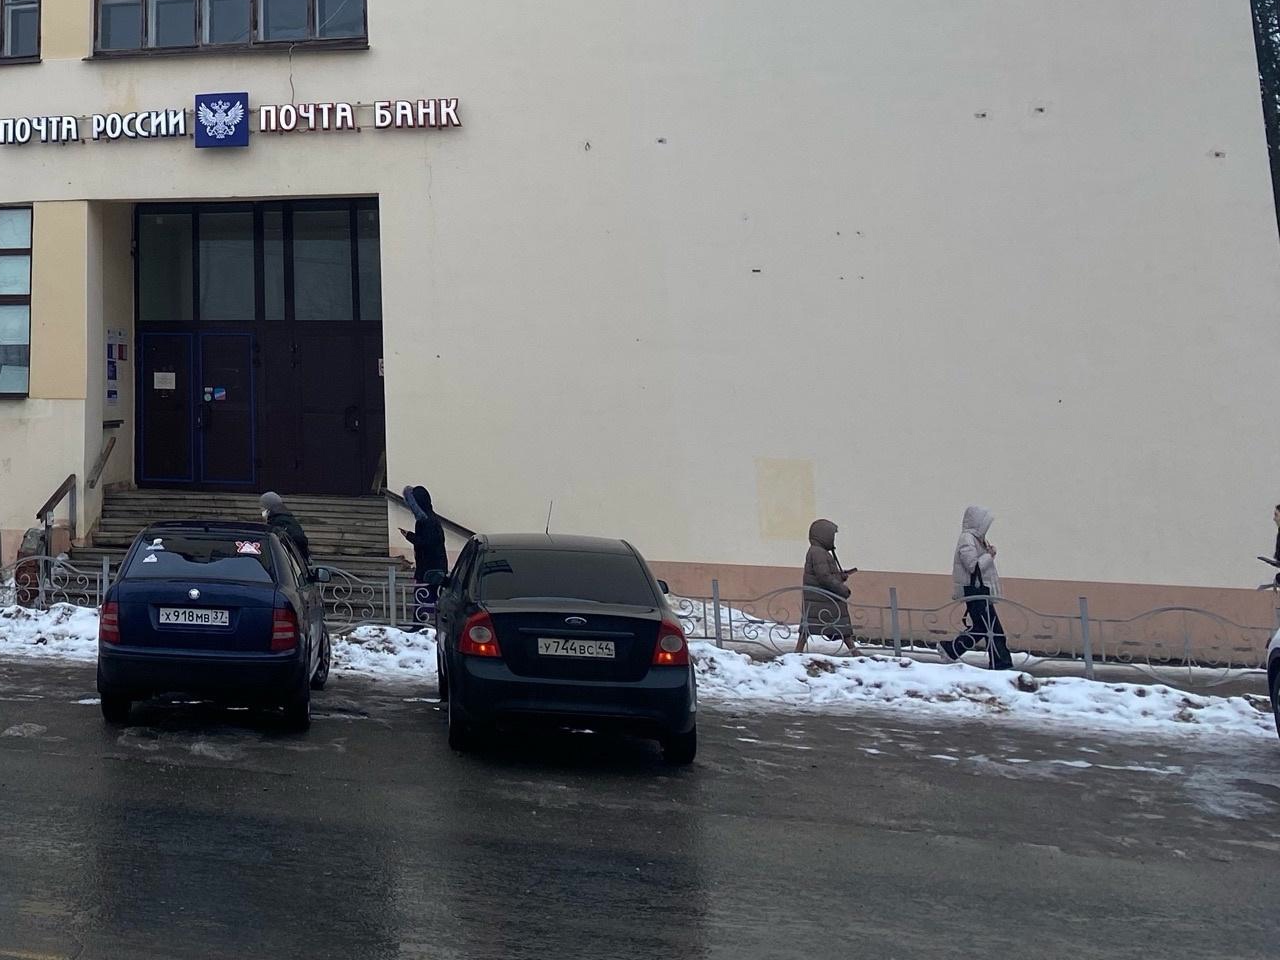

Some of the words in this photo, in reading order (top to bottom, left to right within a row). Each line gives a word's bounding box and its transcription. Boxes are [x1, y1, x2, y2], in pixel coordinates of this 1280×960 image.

[0, 116, 78, 144] ПОЧТА
[92, 108, 186, 140] РОССИИ
[260, 102, 355, 132] ПОЧТА
[374, 98, 461, 128] БАНК
